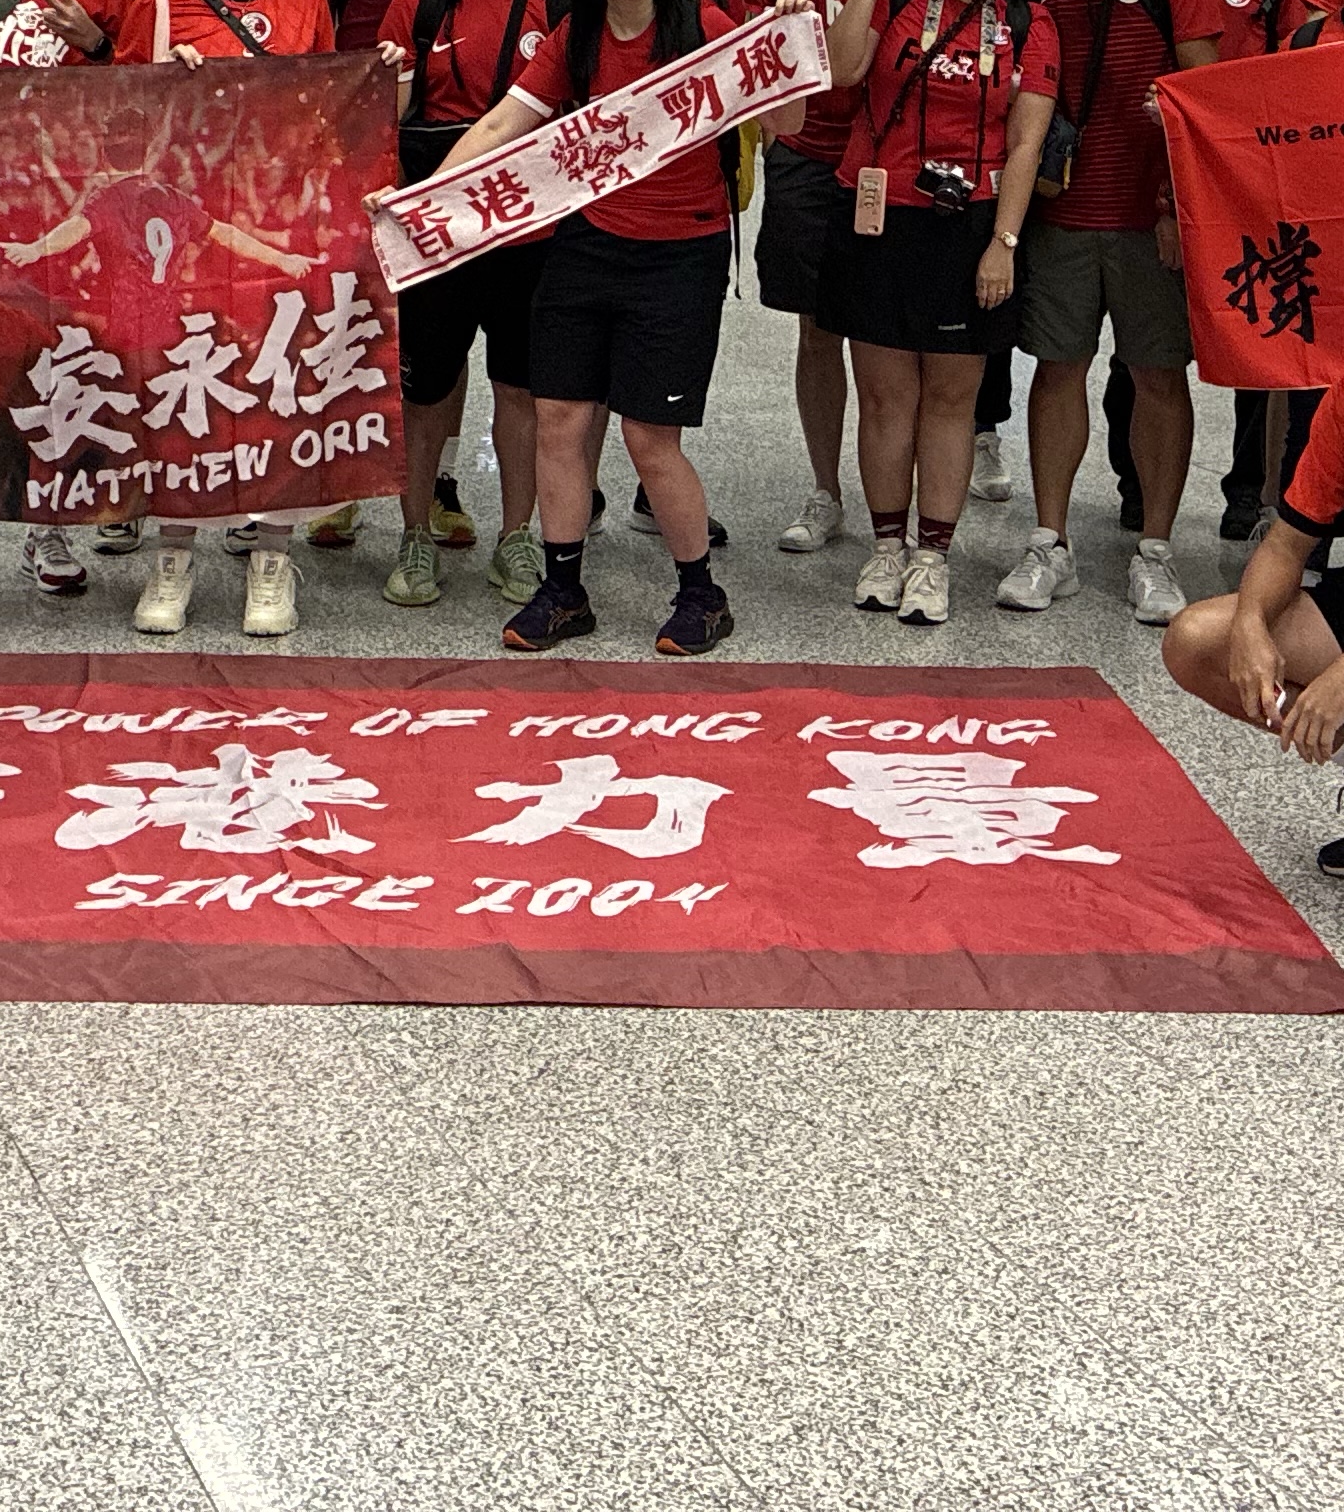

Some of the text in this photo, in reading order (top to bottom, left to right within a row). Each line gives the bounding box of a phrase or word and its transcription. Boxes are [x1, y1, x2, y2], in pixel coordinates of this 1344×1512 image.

[557, 103, 603, 149] HK
[1256, 125, 1301, 146] We
[587, 163, 636, 196] FA
[396, 168, 536, 260] 香港
[145, 217, 175, 284] 9
[8, 271, 388, 463] 安永佳
[25, 412, 390, 512] MATTHEW ORR
[349, 707, 493, 738] OF
[508, 710, 766, 743] HONG
[795, 714, 1058, 745] KONG
[73, 871, 730, 916] SINCE 2004
